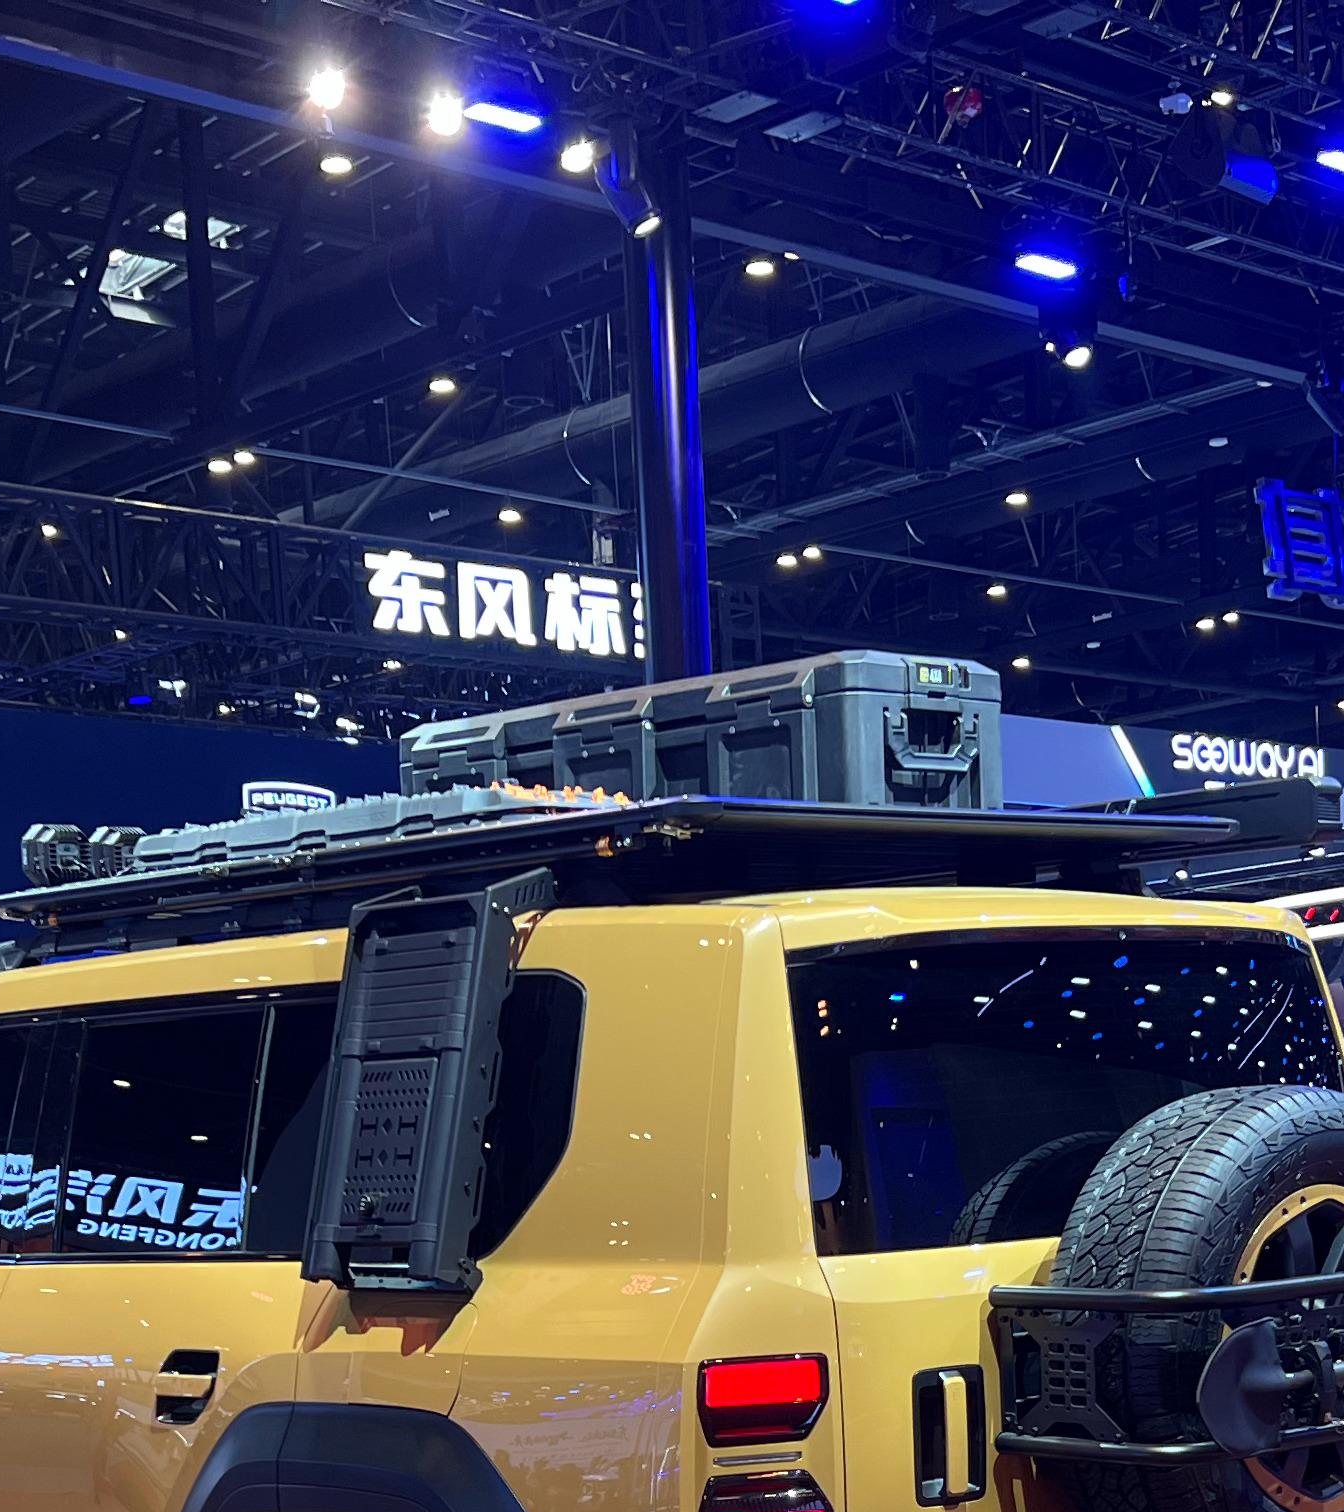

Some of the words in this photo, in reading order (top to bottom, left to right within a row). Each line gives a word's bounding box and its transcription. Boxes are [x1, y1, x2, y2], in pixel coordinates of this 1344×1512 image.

[364, 550, 645, 659] 东风标
[251, 791, 328, 809] PEUGEOT
